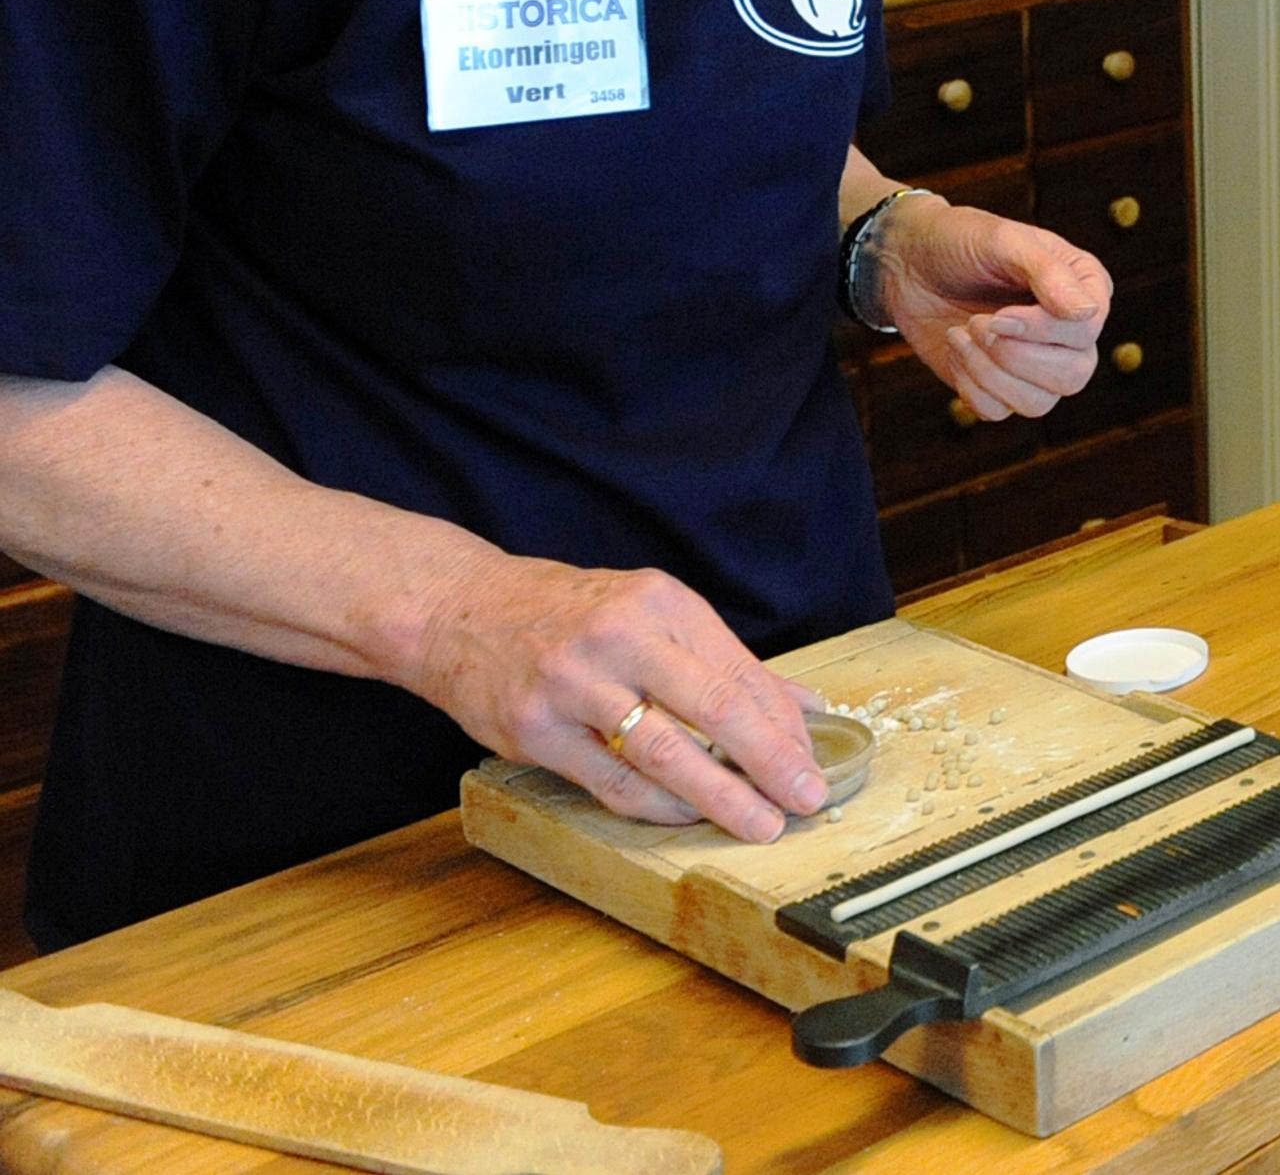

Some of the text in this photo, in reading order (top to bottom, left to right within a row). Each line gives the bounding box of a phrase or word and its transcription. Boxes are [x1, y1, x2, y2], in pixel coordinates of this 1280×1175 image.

[458, 39, 616, 71] Ekornringen
[505, 83, 626, 104] Vert 3458
